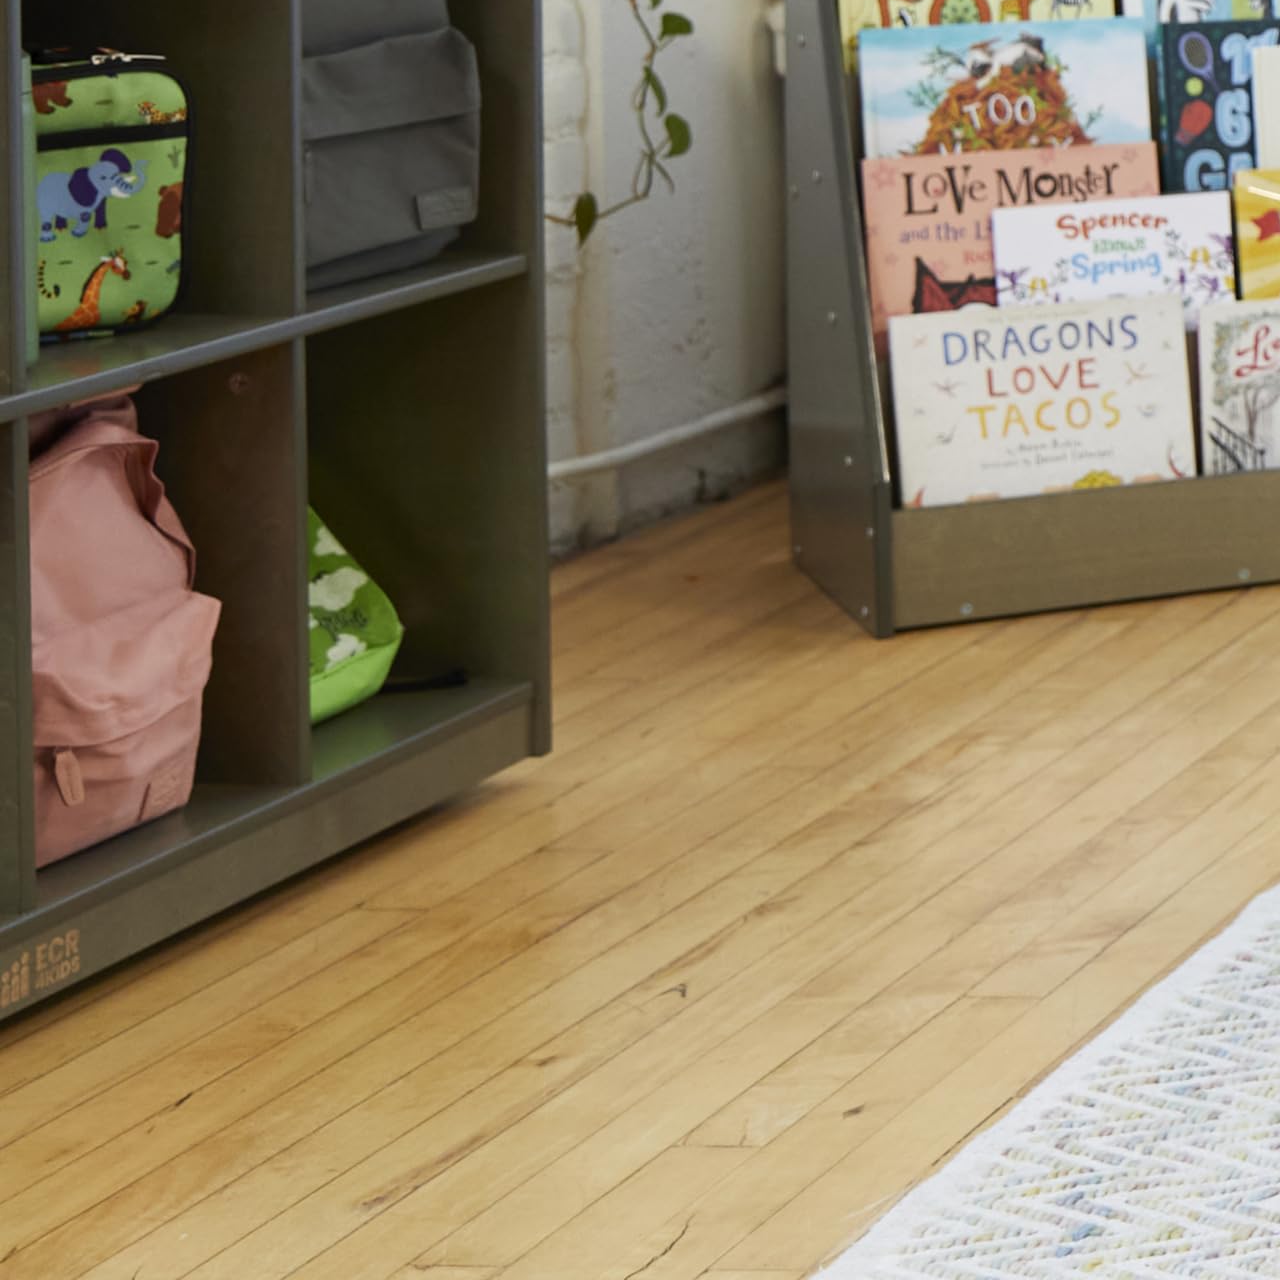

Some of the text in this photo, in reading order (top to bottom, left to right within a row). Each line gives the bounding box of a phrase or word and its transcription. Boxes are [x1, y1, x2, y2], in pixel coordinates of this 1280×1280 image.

[962, 93, 1036, 131] TOO
[900, 224, 928, 243] and
[935, 222, 965, 242] the
[1056, 212, 1168, 240] Spencer
[1071, 252, 1162, 284] Spring
[943, 315, 1138, 365] DRAGONS
[986, 357, 1099, 398] LOVE
[966, 391, 1121, 440] TACOS
